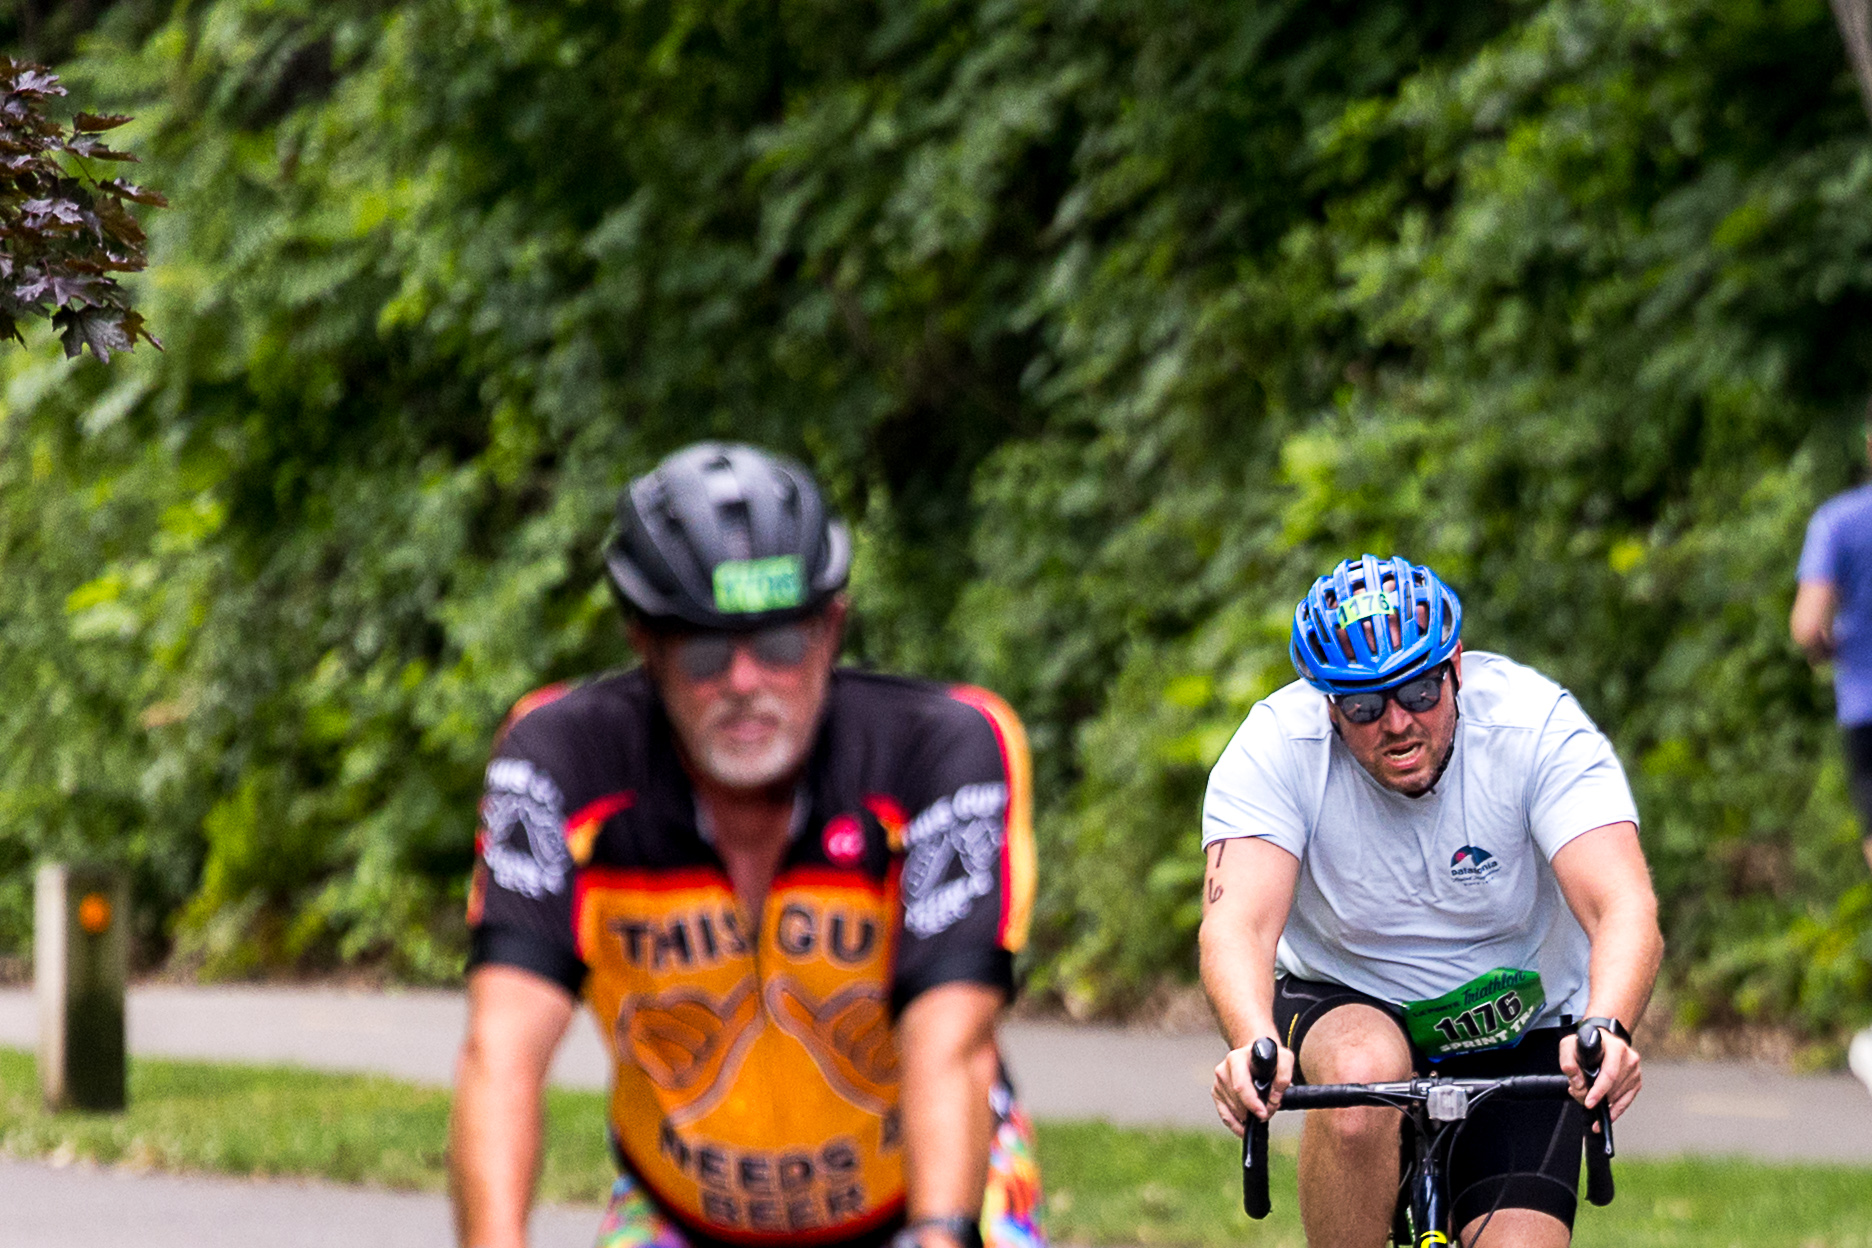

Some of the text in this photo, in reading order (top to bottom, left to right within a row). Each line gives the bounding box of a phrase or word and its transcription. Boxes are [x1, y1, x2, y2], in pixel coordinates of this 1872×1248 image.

[1338, 593, 1390, 622] 1176
[606, 911, 752, 970] THIS
[1461, 970, 1526, 1006] Triathlon
[1433, 990, 1522, 1042] 1176
[1439, 1030, 1508, 1052] SPRINT
[660, 1117, 857, 1190] NEEDS
